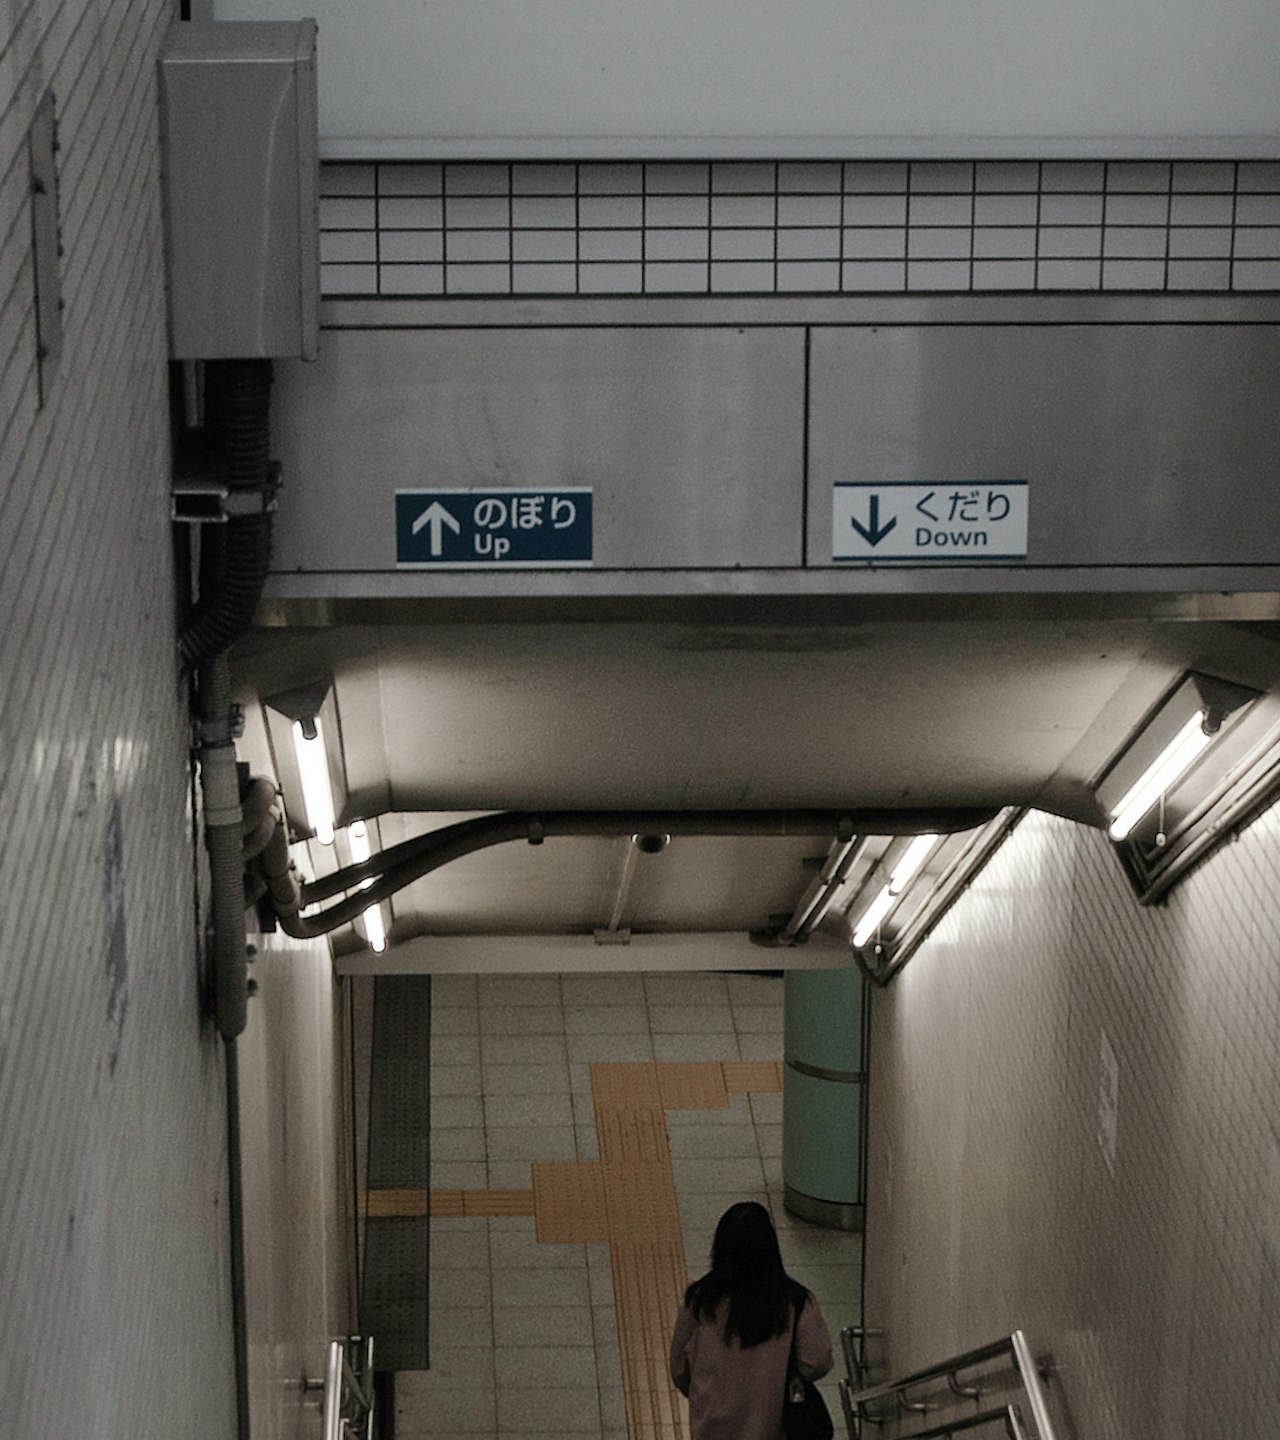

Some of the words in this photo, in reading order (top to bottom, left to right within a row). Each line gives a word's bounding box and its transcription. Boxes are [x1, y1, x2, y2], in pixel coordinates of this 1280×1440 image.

[473, 492, 577, 530] のぼり
[915, 490, 1012, 523] くだり
[474, 533, 510, 560] Up
[915, 527, 989, 548] Down
